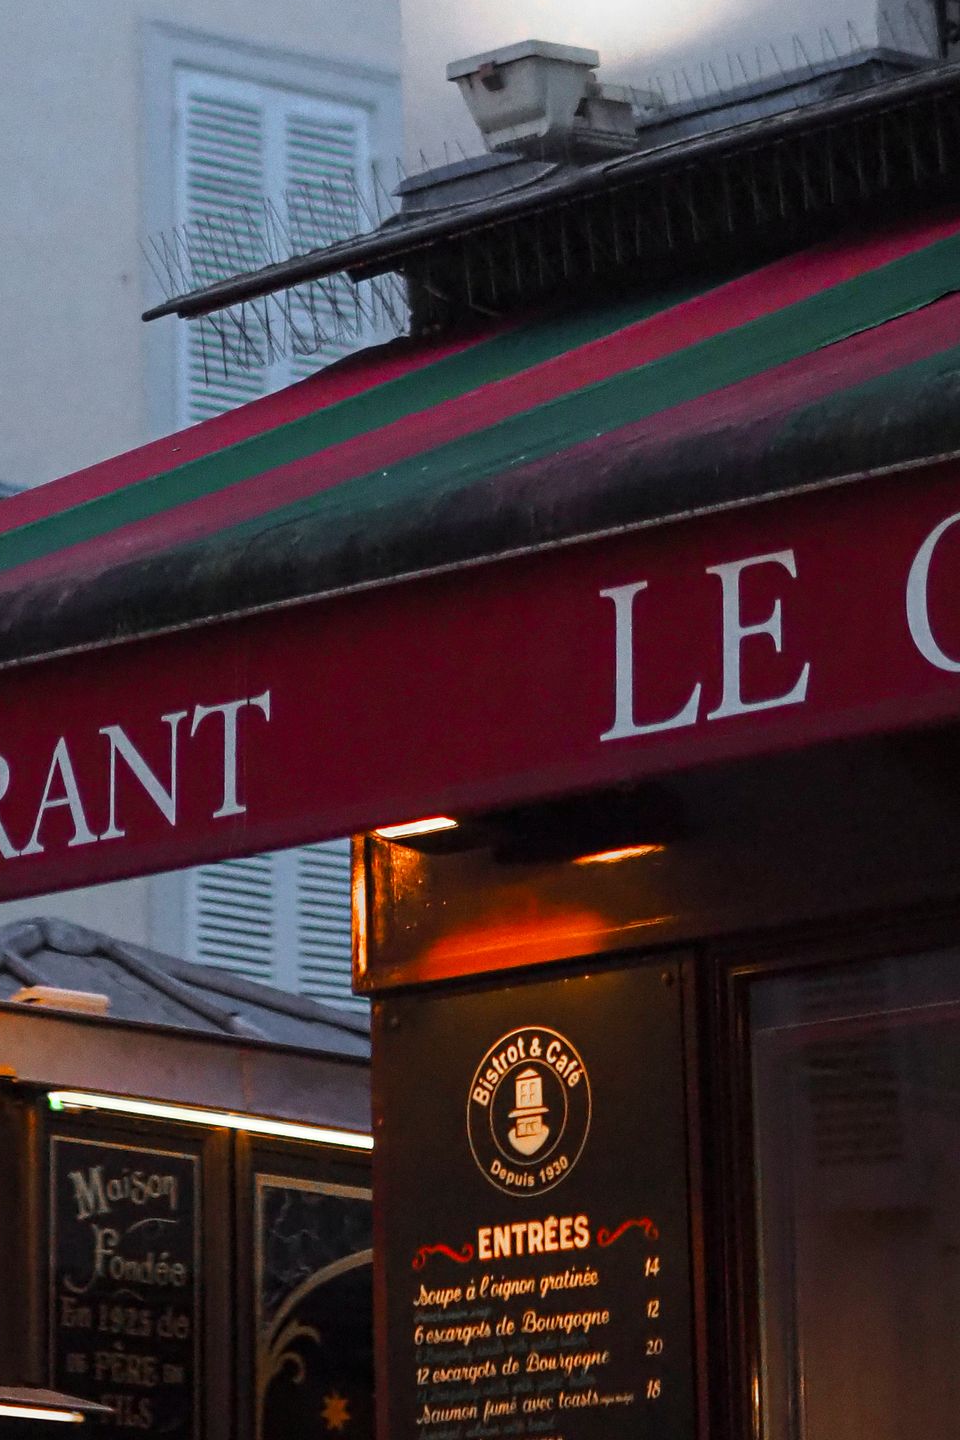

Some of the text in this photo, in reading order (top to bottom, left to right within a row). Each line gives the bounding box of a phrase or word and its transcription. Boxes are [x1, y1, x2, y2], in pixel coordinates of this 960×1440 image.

[599, 548, 811, 743] LE
[472, 1036, 584, 1107] Bistrot & Café
[66, 1165, 178, 1221] Maison
[489, 1155, 570, 1188] Depuis 1930
[64, 1223, 185, 1294] Fondée
[478, 1215, 590, 1261] ENTRÉES
[413, 1256, 661, 1310] Soupe à l'oignon gratinée 14
[414, 1324, 424, 1346] 6
[425, 1318, 492, 1347] escargots
[496, 1314, 516, 1337] de
[521, 1308, 611, 1335] Bourgogne
[646, 1297, 661, 1319] 12
[416, 1337, 664, 1386] 12 escargots de Bourgogne 20
[416, 1402, 479, 1426] Saumon
[483, 1400, 518, 1424] fumé
[522, 1396, 553, 1413] avec
[558, 1389, 601, 1410] toasts
[645, 1378, 662, 1400] 18
